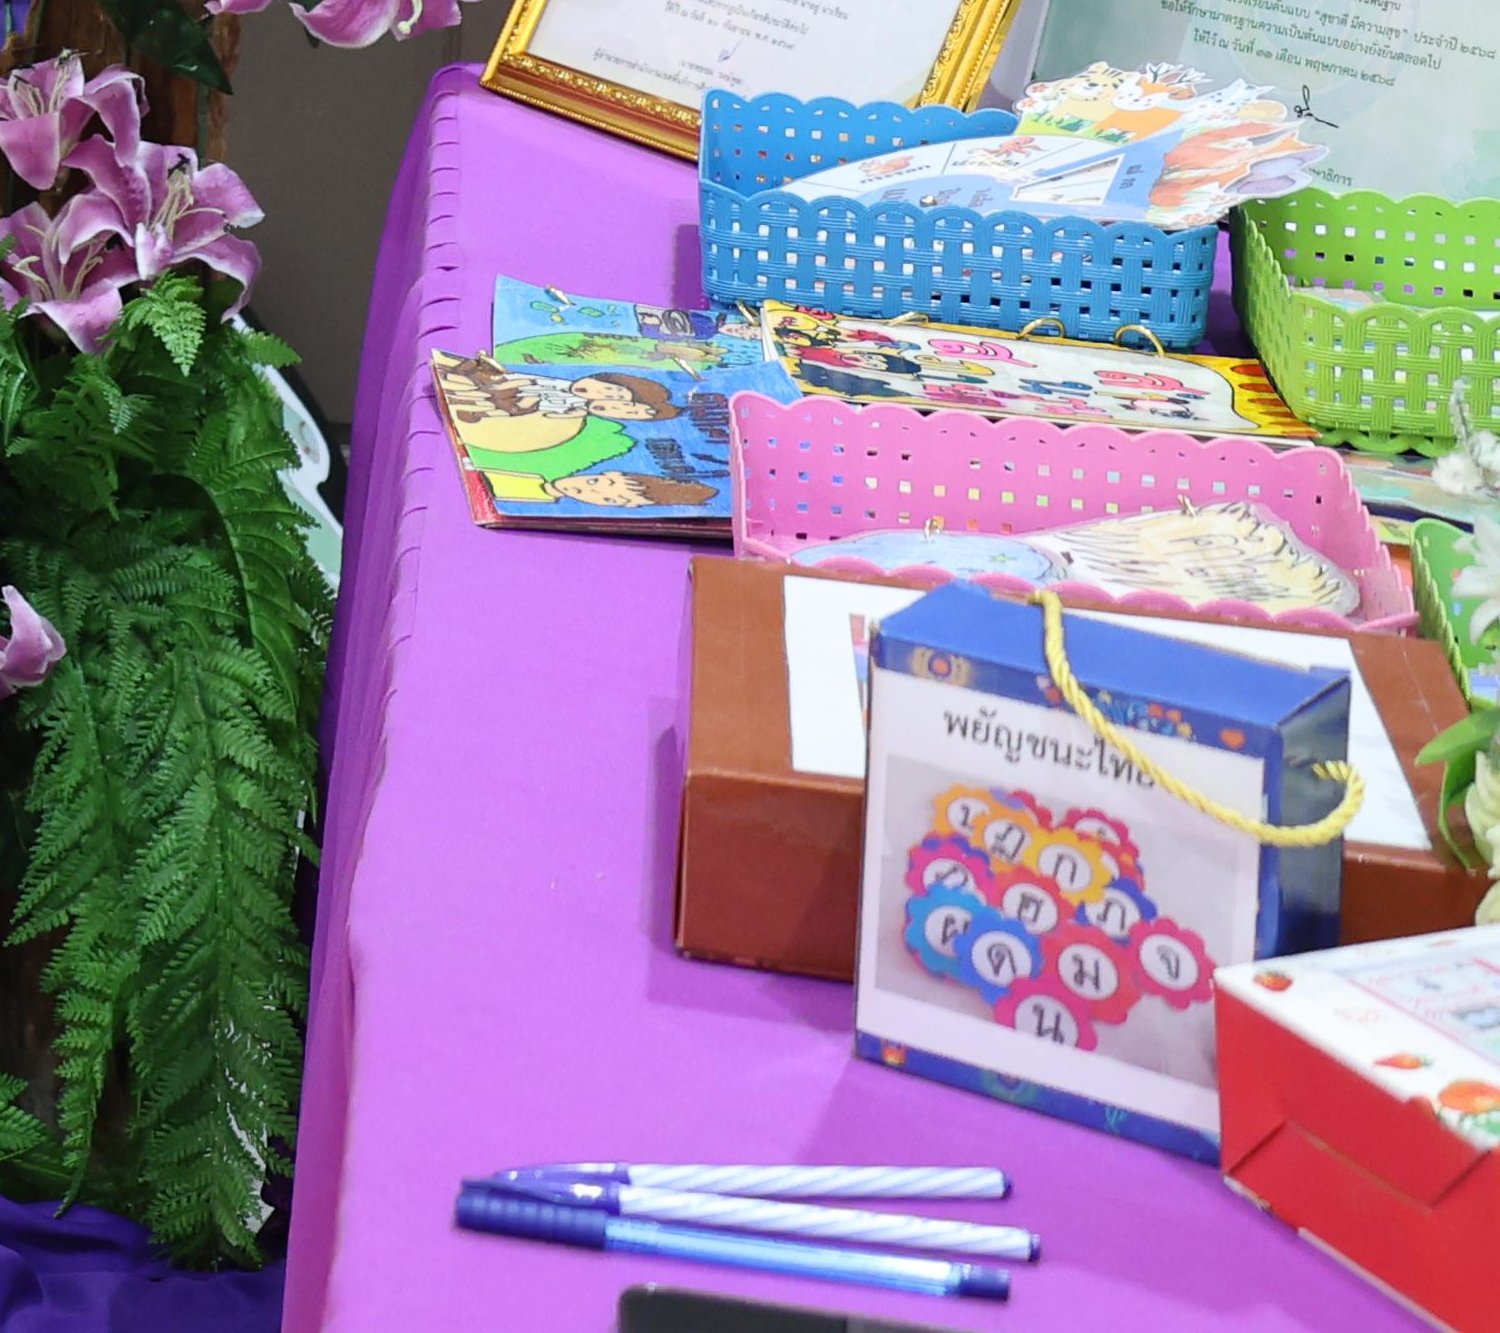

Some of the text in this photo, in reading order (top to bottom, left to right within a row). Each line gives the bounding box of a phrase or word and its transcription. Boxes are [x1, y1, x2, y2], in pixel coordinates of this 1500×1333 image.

[1231, 36, 1255, 55] วันที่
[1274, 47, 1303, 67] เดือน
[1303, 57, 1359, 81] พฤษภาคม
[1413, 28, 1459, 54] ประจำปี
